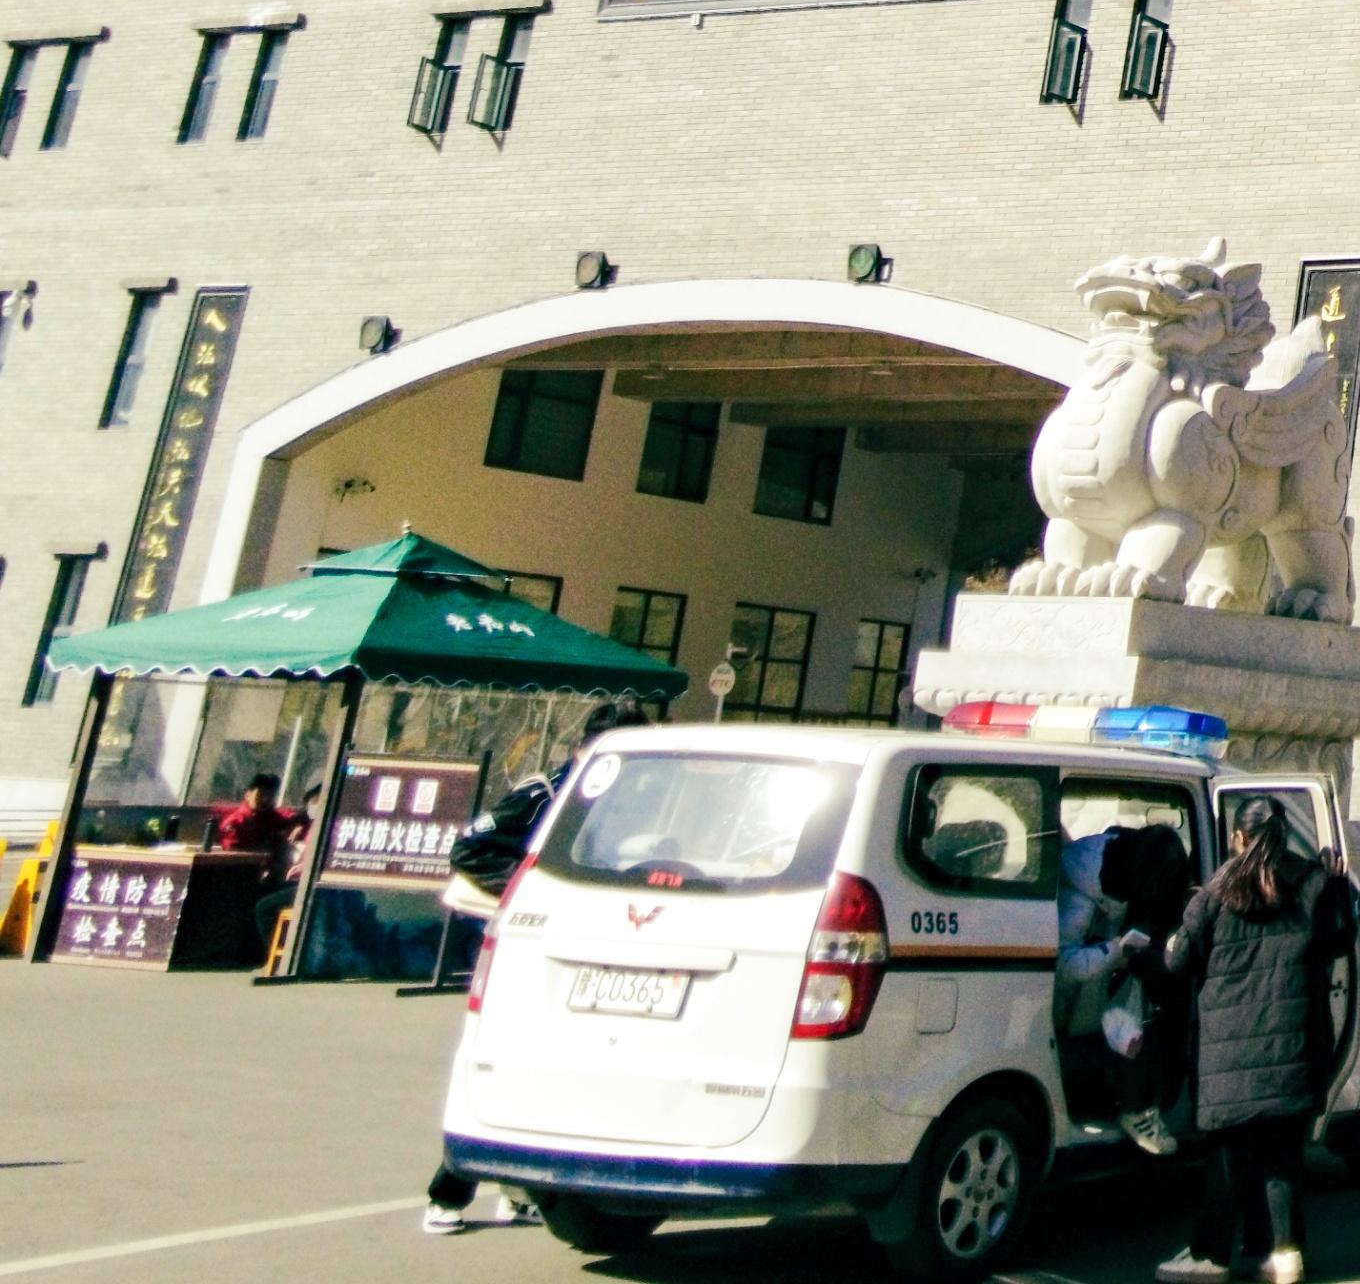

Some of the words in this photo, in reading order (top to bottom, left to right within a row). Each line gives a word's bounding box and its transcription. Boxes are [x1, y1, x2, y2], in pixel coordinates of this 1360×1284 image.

[336, 817, 458, 854] 护林防火检查点
[72, 915, 146, 948] 检查点
[911, 911, 958, 934] 0365
